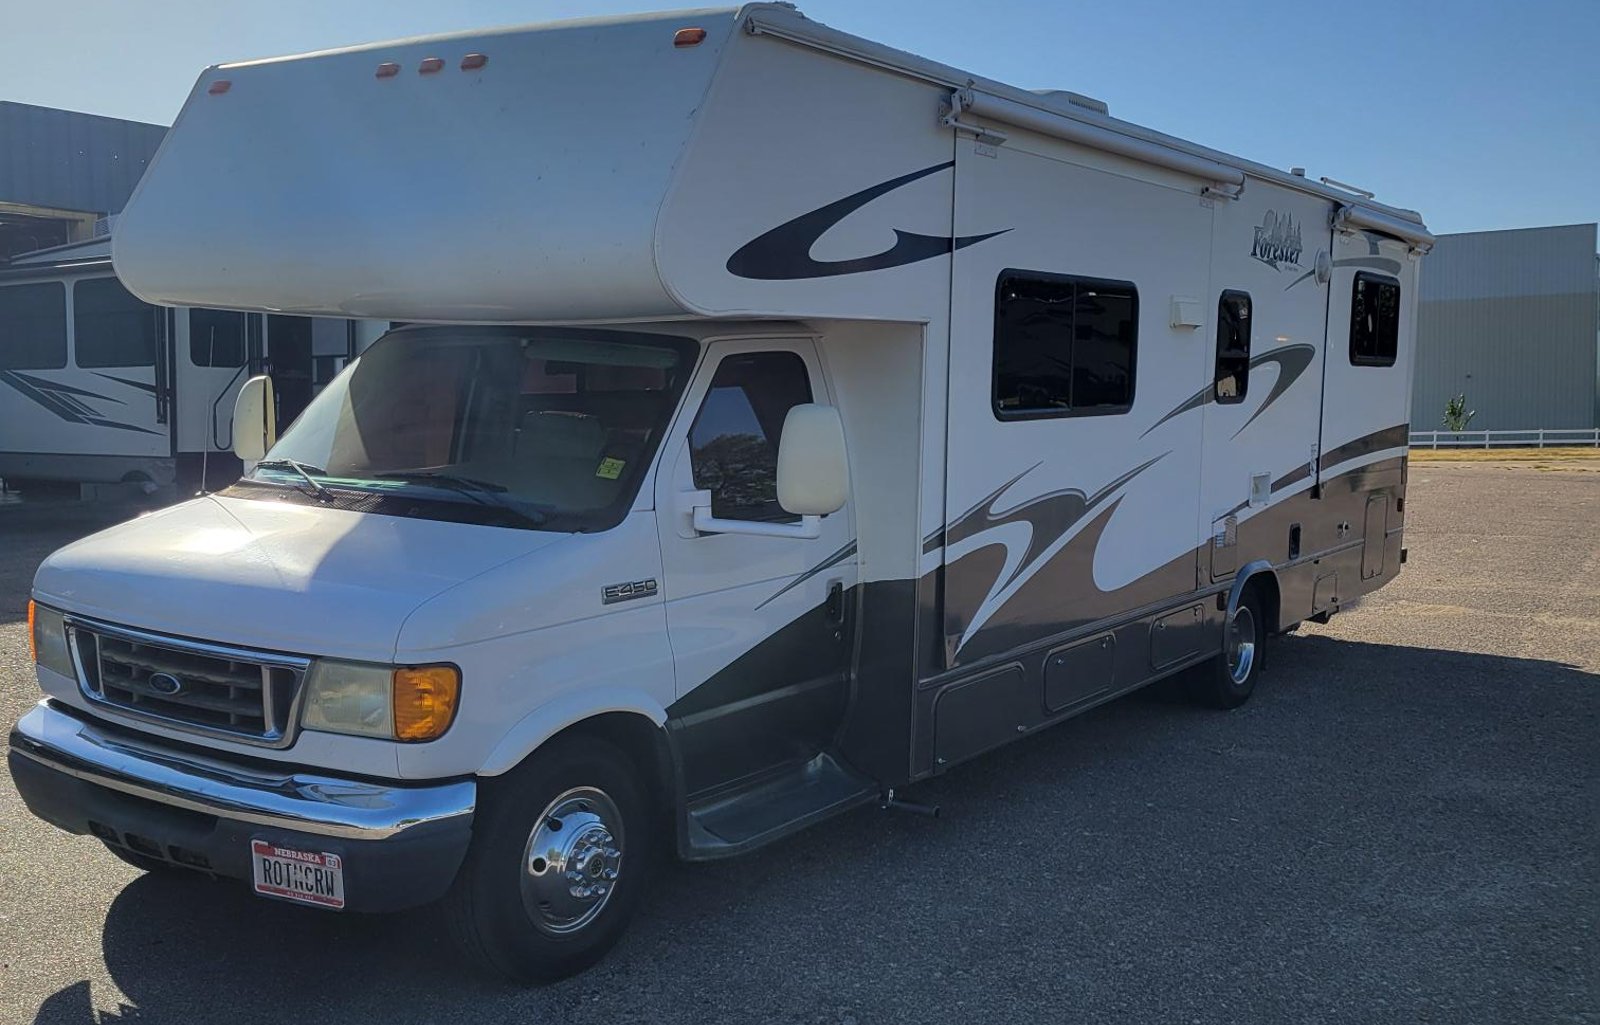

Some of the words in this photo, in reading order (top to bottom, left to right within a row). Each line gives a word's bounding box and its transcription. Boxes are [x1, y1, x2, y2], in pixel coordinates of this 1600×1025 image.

[1250, 225, 1303, 265] Forester
[604, 579, 657, 598] E450
[274, 847, 322, 864] NEBRASKA
